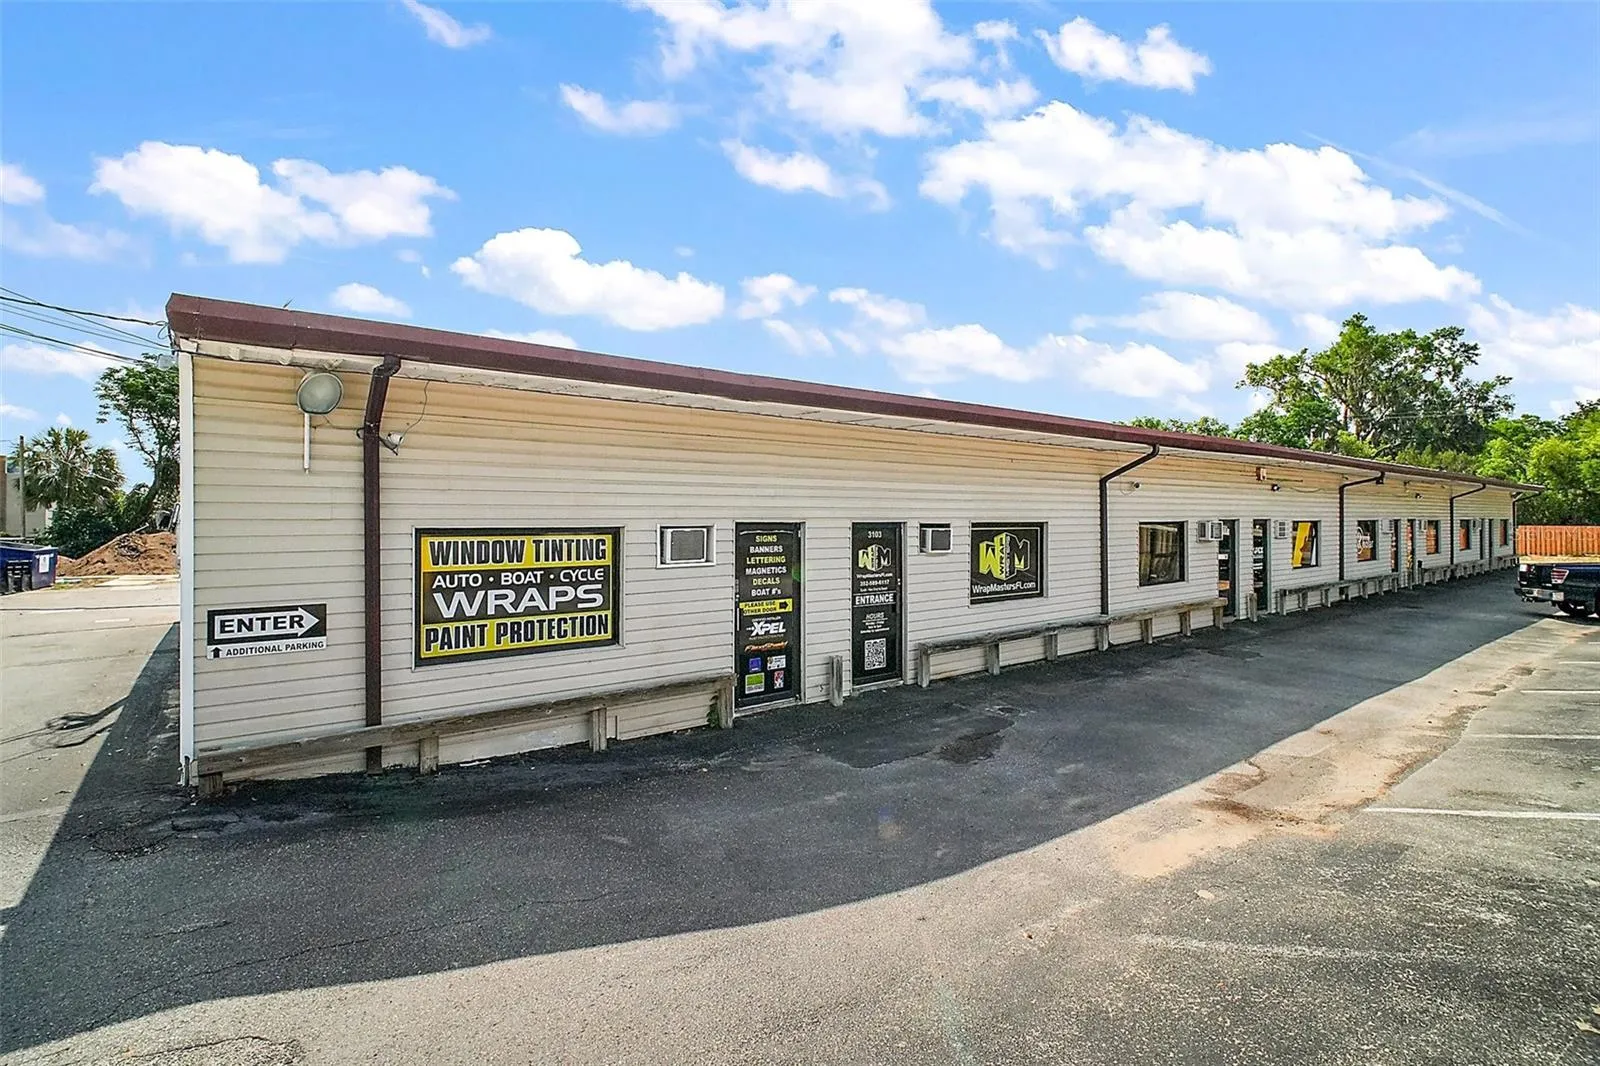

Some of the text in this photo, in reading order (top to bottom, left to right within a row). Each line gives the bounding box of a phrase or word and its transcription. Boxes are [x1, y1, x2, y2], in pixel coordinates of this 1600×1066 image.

[755, 535, 777, 543] SIGNS
[429, 538, 607, 567] WINDOW TINTING
[749, 545, 783, 553] BANNERS
[746, 556, 786, 565] LETTERING
[745, 566, 787, 575] MAGNETICS
[432, 568, 604, 589] AUTO BOAT CYCLE
[752, 577, 780, 586] DECALS
[751, 588, 770, 597] BOAT
[972, 581, 1036, 594] WrapMastersFL.com
[432, 584, 604, 619] WRAPS
[855, 593, 894, 605] ENTRANCE
[219, 614, 305, 634] ENTER
[750, 620, 786, 637] XPEL
[425, 614, 609, 652] PAINT PROTECTION
[226, 641, 324, 657] ADDITIONAL PARKING
